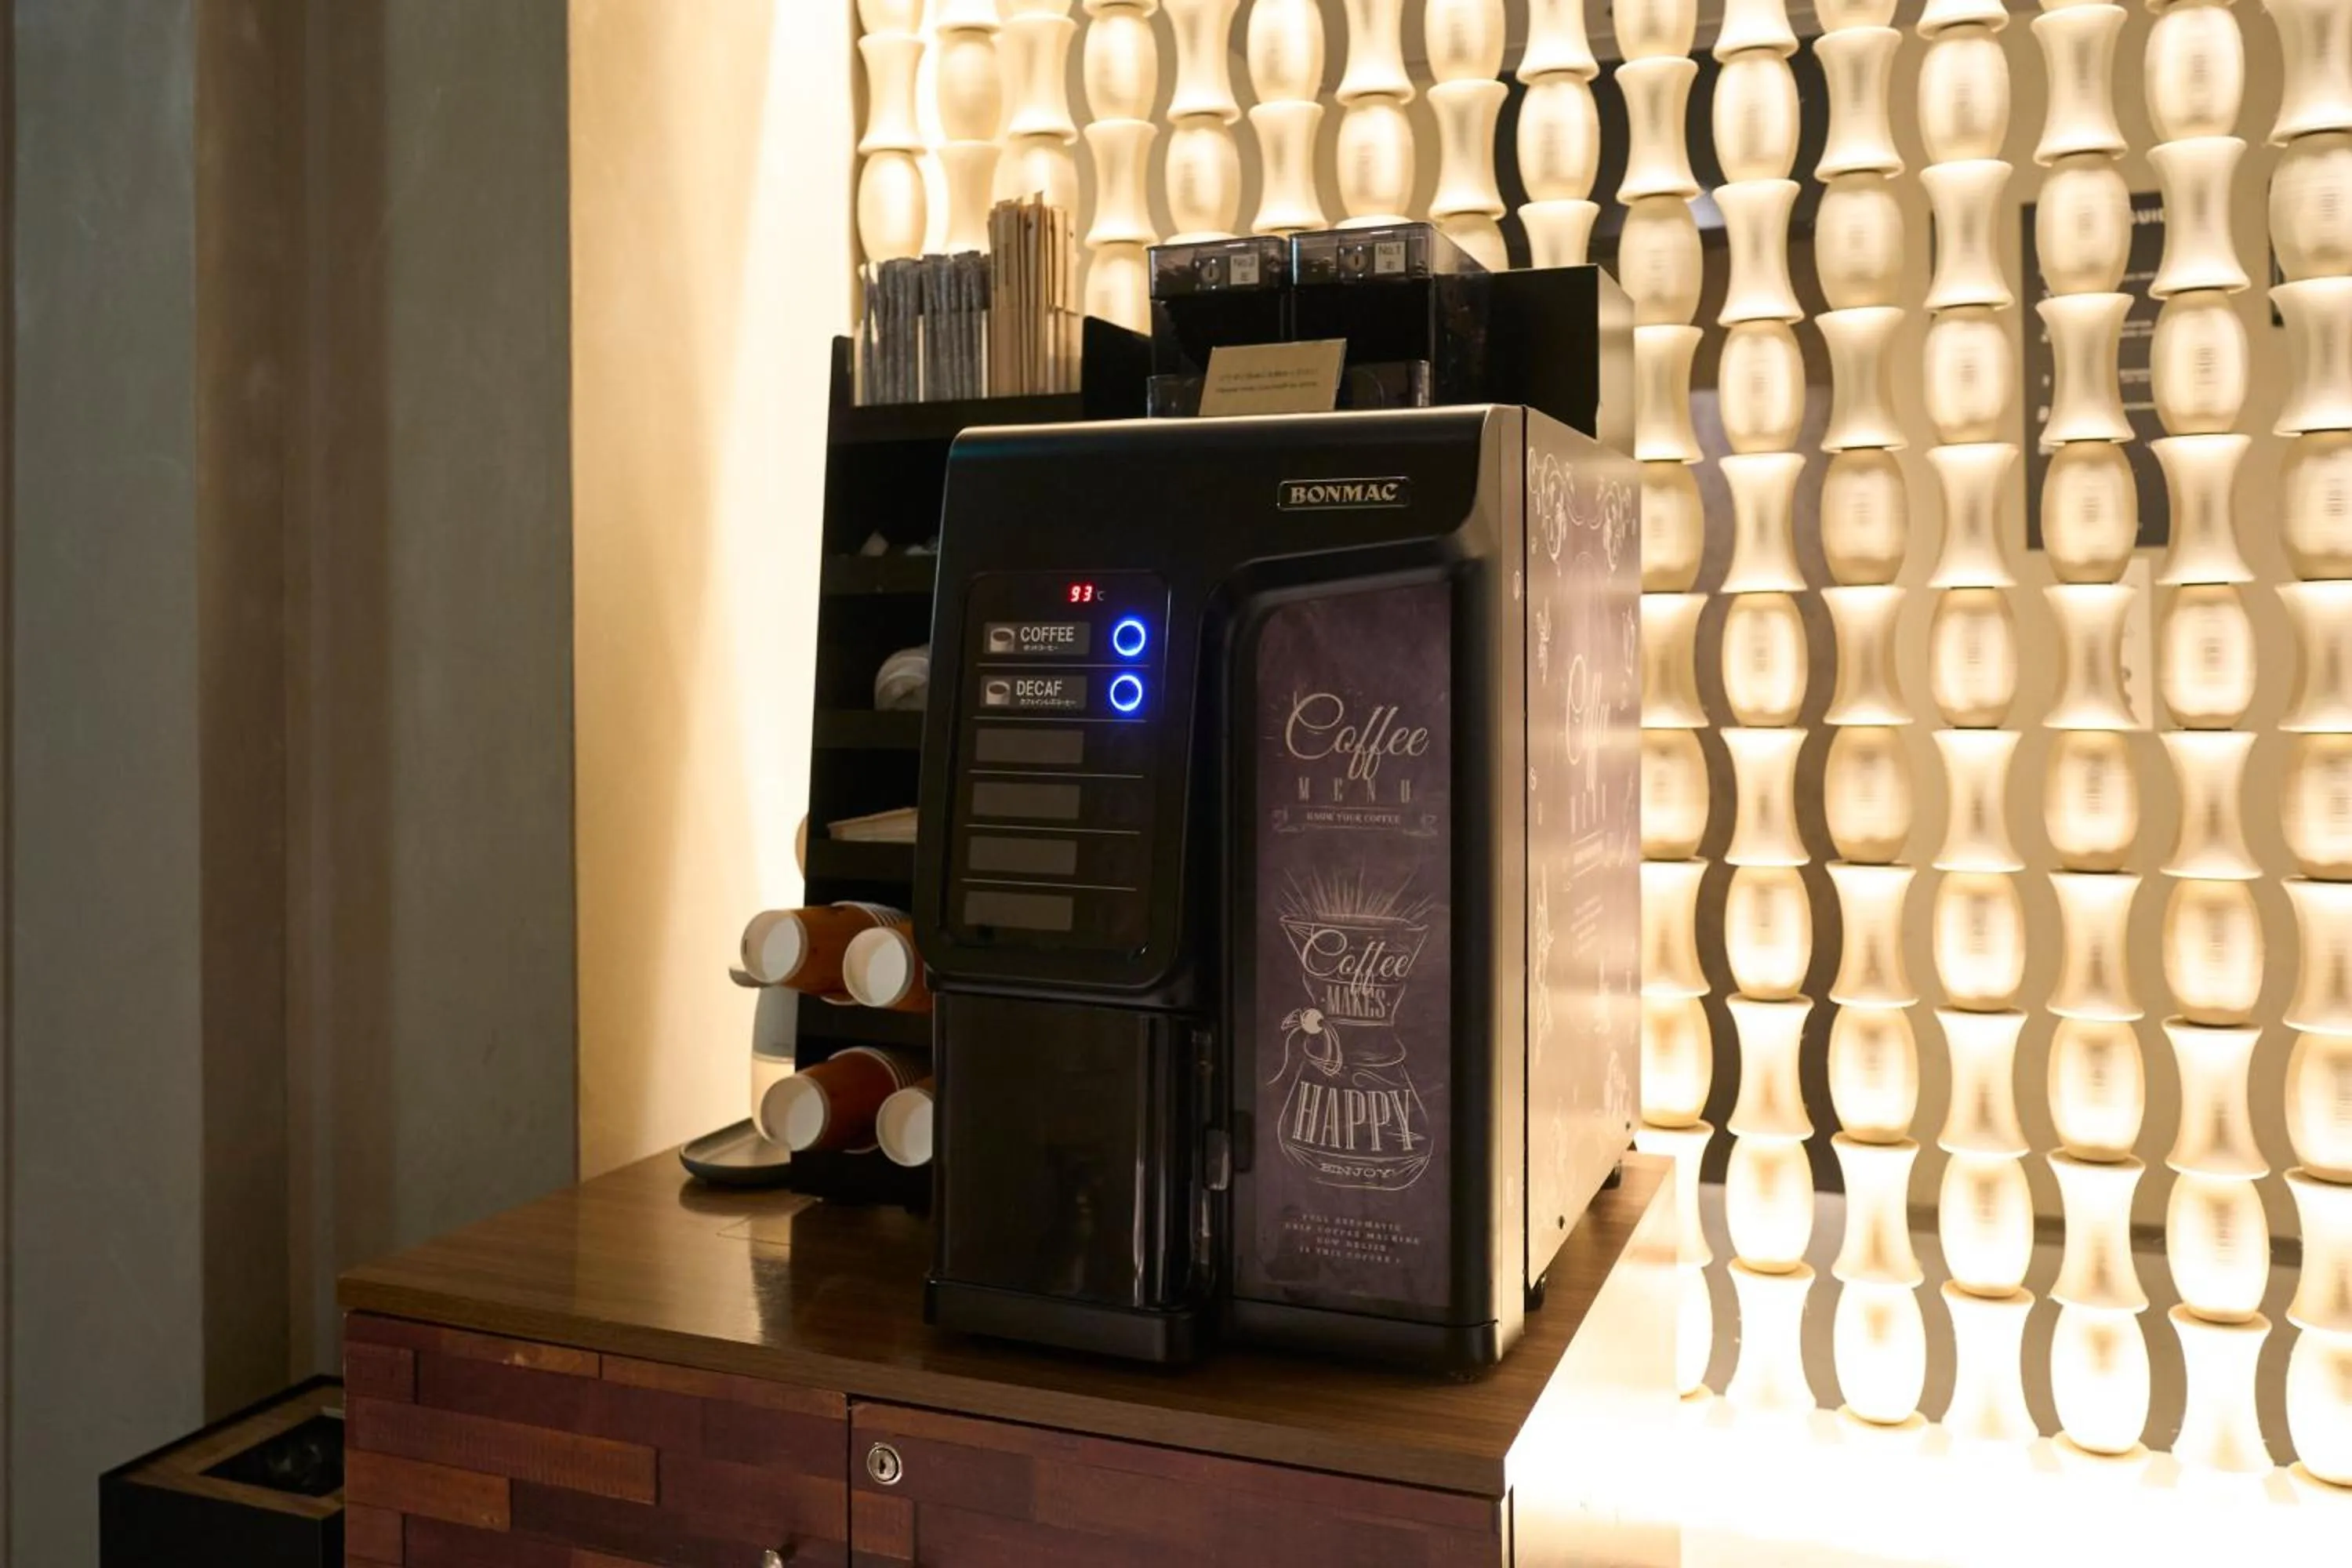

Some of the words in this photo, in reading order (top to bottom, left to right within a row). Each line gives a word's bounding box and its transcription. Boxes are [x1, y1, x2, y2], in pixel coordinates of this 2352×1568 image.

[1289, 484, 1399, 504] BONMAC
[1070, 586, 1093, 602] 93
[1020, 626, 1075, 642] COFFEE
[1016, 680, 1062, 697] DECAF
[1286, 691, 1430, 779] Coffee
[1298, 777, 1410, 804] MENU
[1363, 813, 1401, 825] COFFEE
[1302, 924, 1410, 996] Coffee
[1327, 985, 1386, 1018] MAKES
[1292, 1081, 1414, 1152] HAPPY
[1319, 1163, 1395, 1178] ENJOY
